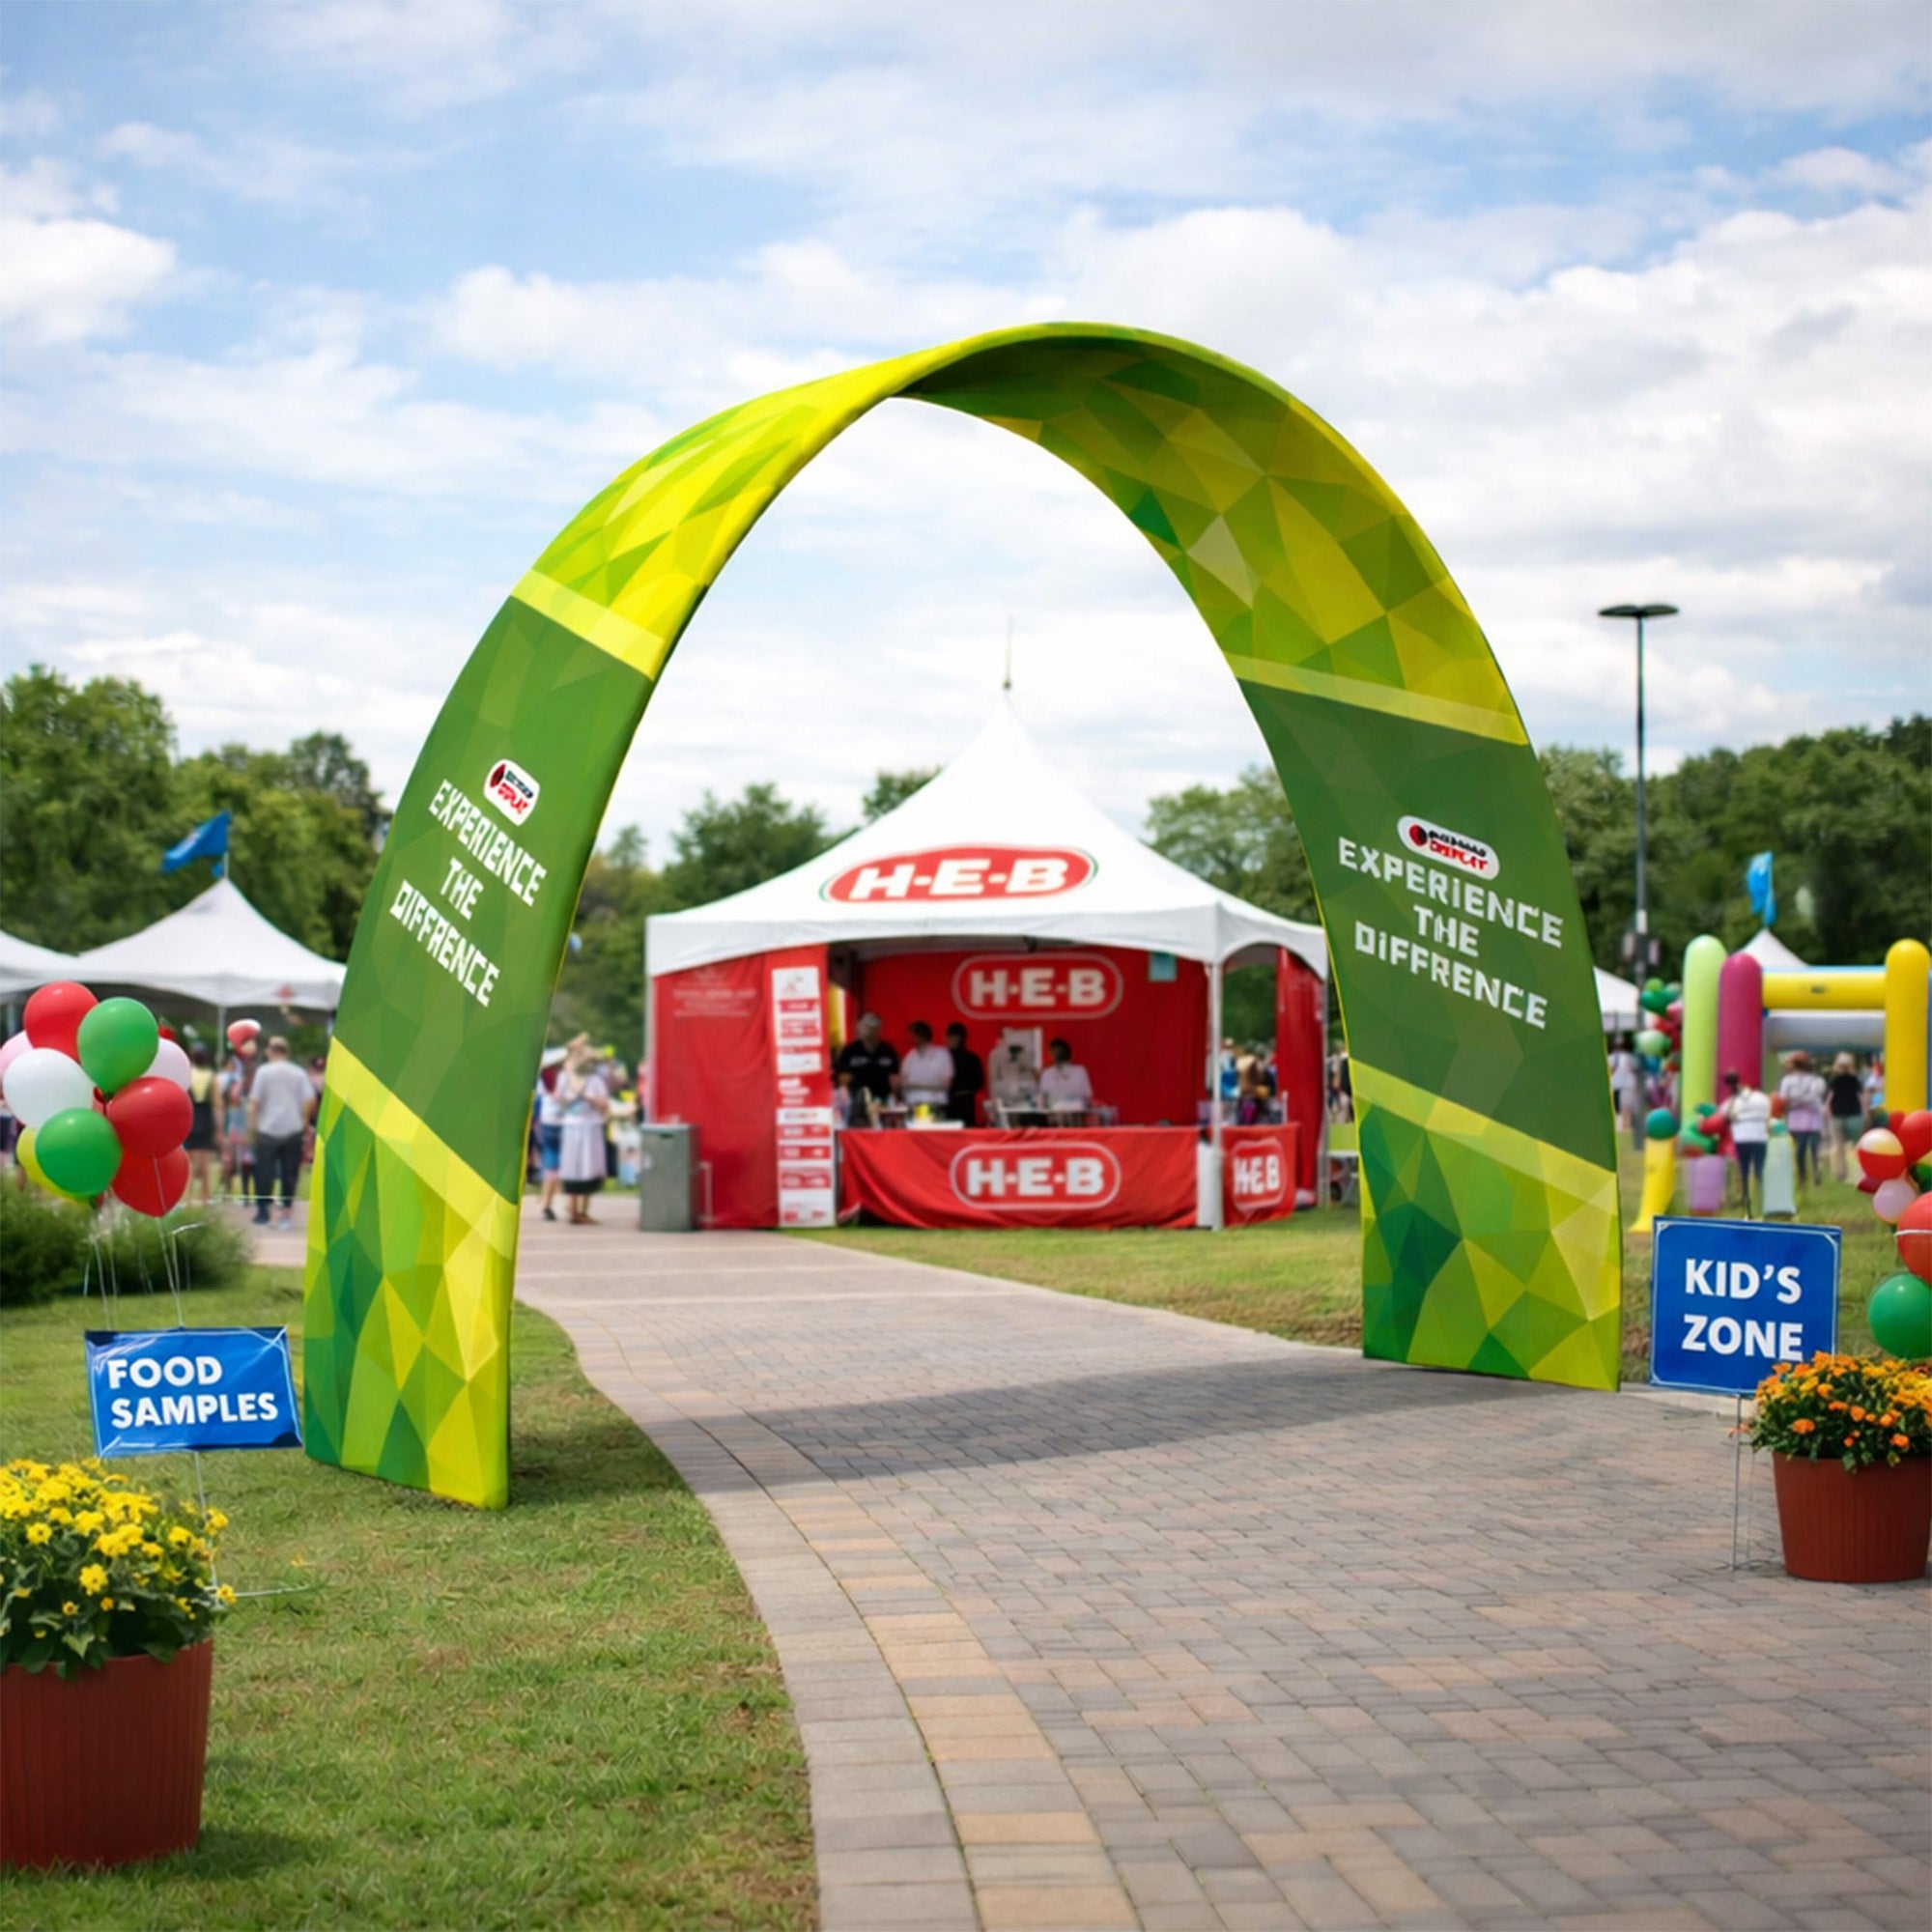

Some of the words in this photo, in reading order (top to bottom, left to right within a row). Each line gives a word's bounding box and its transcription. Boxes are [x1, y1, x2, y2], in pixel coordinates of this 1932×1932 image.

[428, 779, 548, 907] EXPERIENCE
[440, 857, 483, 920] THE
[1339, 837, 1563, 949] EXPERIENCE
[389, 879, 500, 1008] DIFFRENCE
[1413, 904, 1479, 957] THE
[1355, 921, 1548, 1029] DIFFRENCE
[1681, 1314, 1804, 1362] ZONE
[107, 1355, 222, 1389] FOOD
[111, 1392, 278, 1429] SAMPLES
